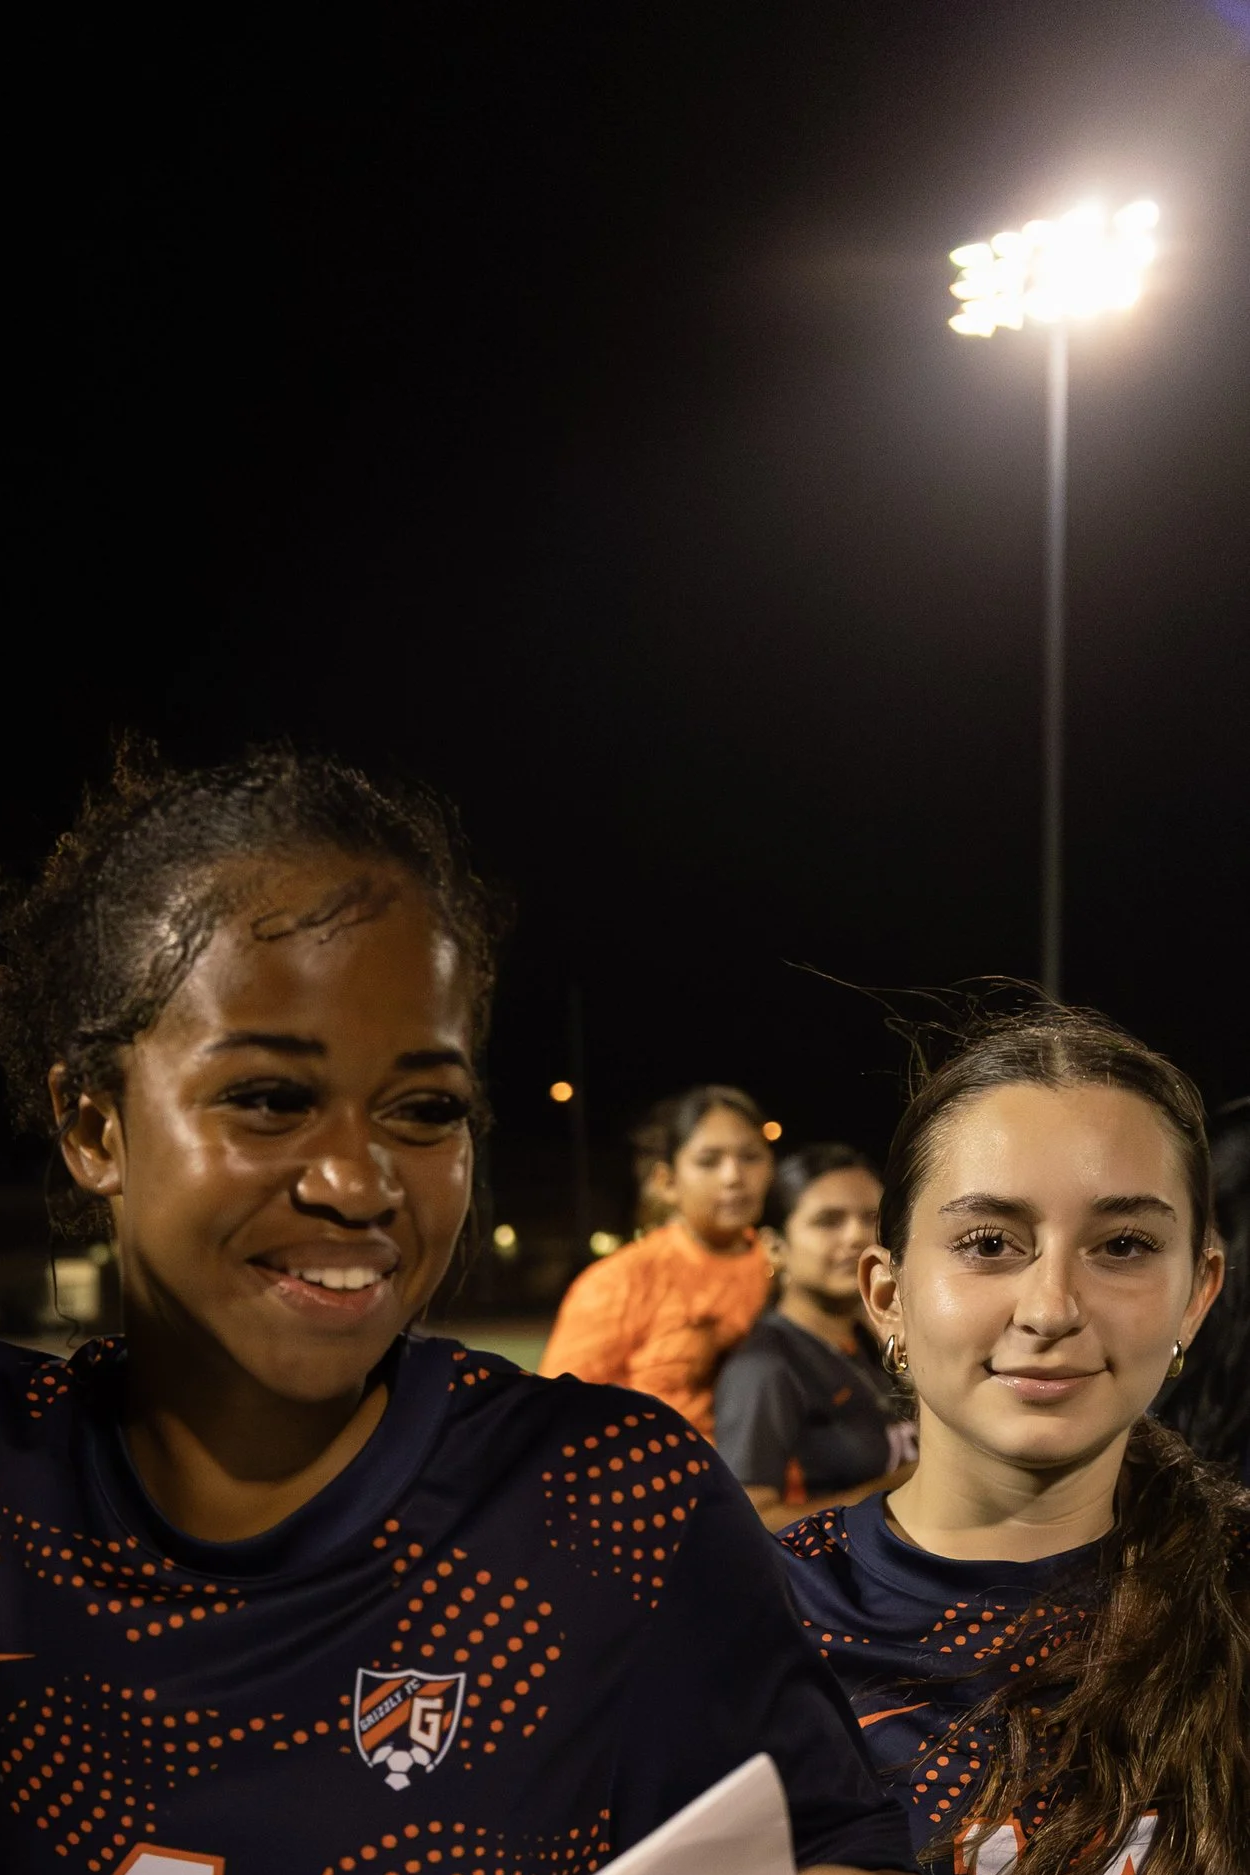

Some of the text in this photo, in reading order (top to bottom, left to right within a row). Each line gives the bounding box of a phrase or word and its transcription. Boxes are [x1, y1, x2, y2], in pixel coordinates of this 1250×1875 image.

[359, 1677, 422, 1732] GRIZZLY FC
[408, 1695, 444, 1752] G
